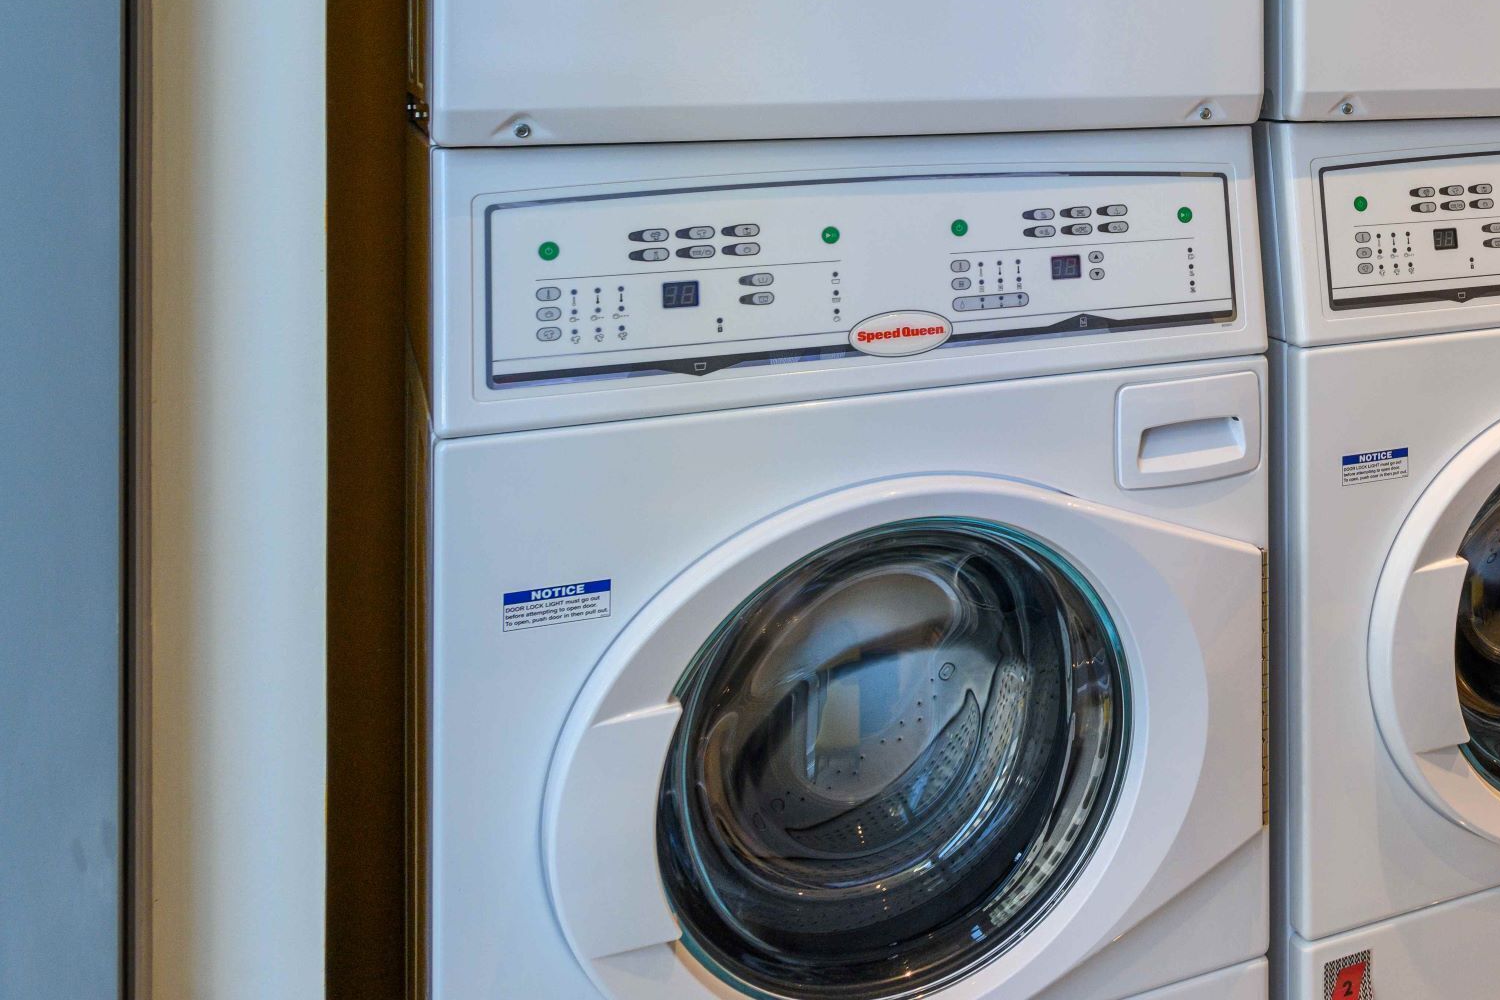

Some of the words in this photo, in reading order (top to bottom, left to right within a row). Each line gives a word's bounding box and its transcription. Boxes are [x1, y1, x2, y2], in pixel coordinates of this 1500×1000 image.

[857, 328, 900, 343] Speed
[902, 326, 944, 337] Queen
[1360, 451, 1392, 462] NOTICE
[531, 584, 585, 600] NOTICE
[505, 613, 524, 621] before
[526, 609, 558, 617] attempting
[1343, 980, 1353, 997] 2
